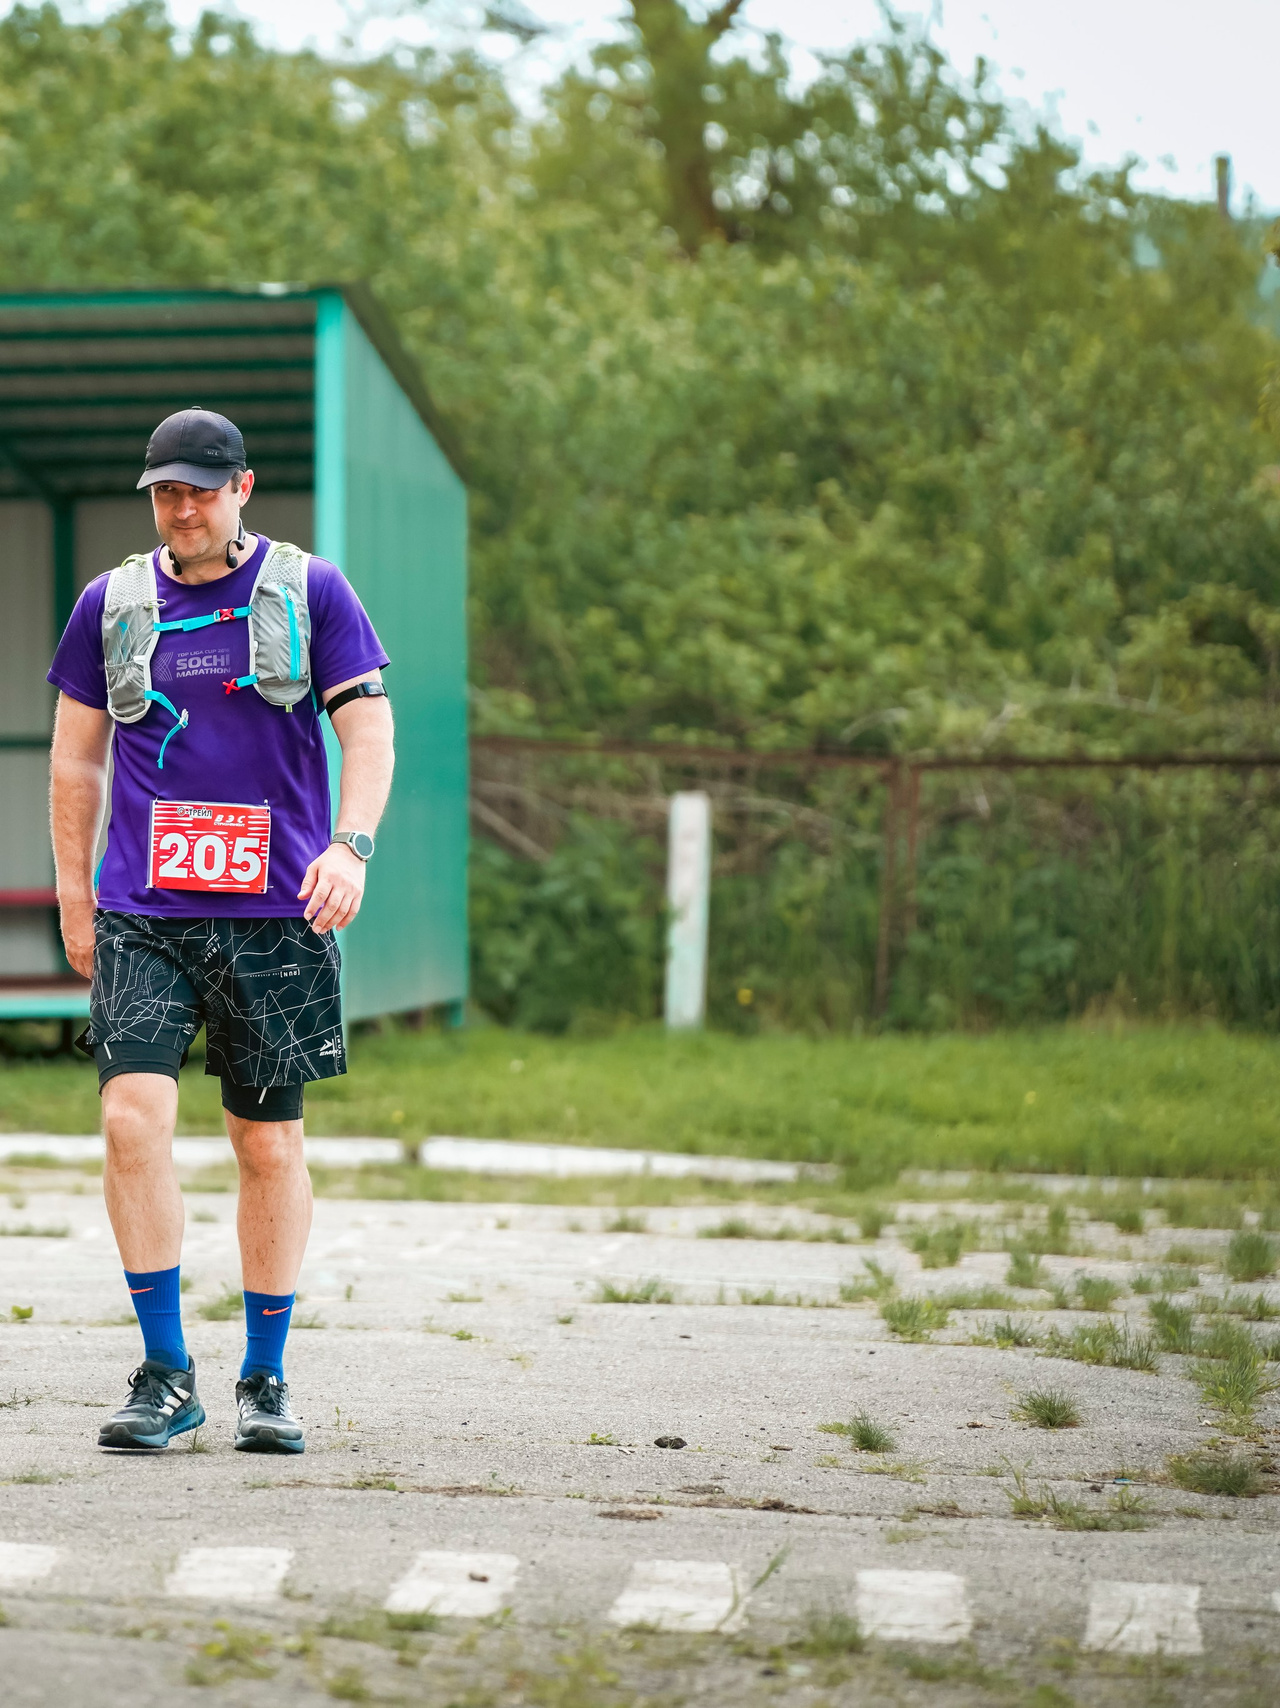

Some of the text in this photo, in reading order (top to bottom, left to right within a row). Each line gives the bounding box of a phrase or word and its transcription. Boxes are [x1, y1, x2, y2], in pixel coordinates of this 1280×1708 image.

[176, 654, 230, 671] SOCHI
[176, 667, 231, 678] MARATHON
[159, 832, 262, 882] 205
